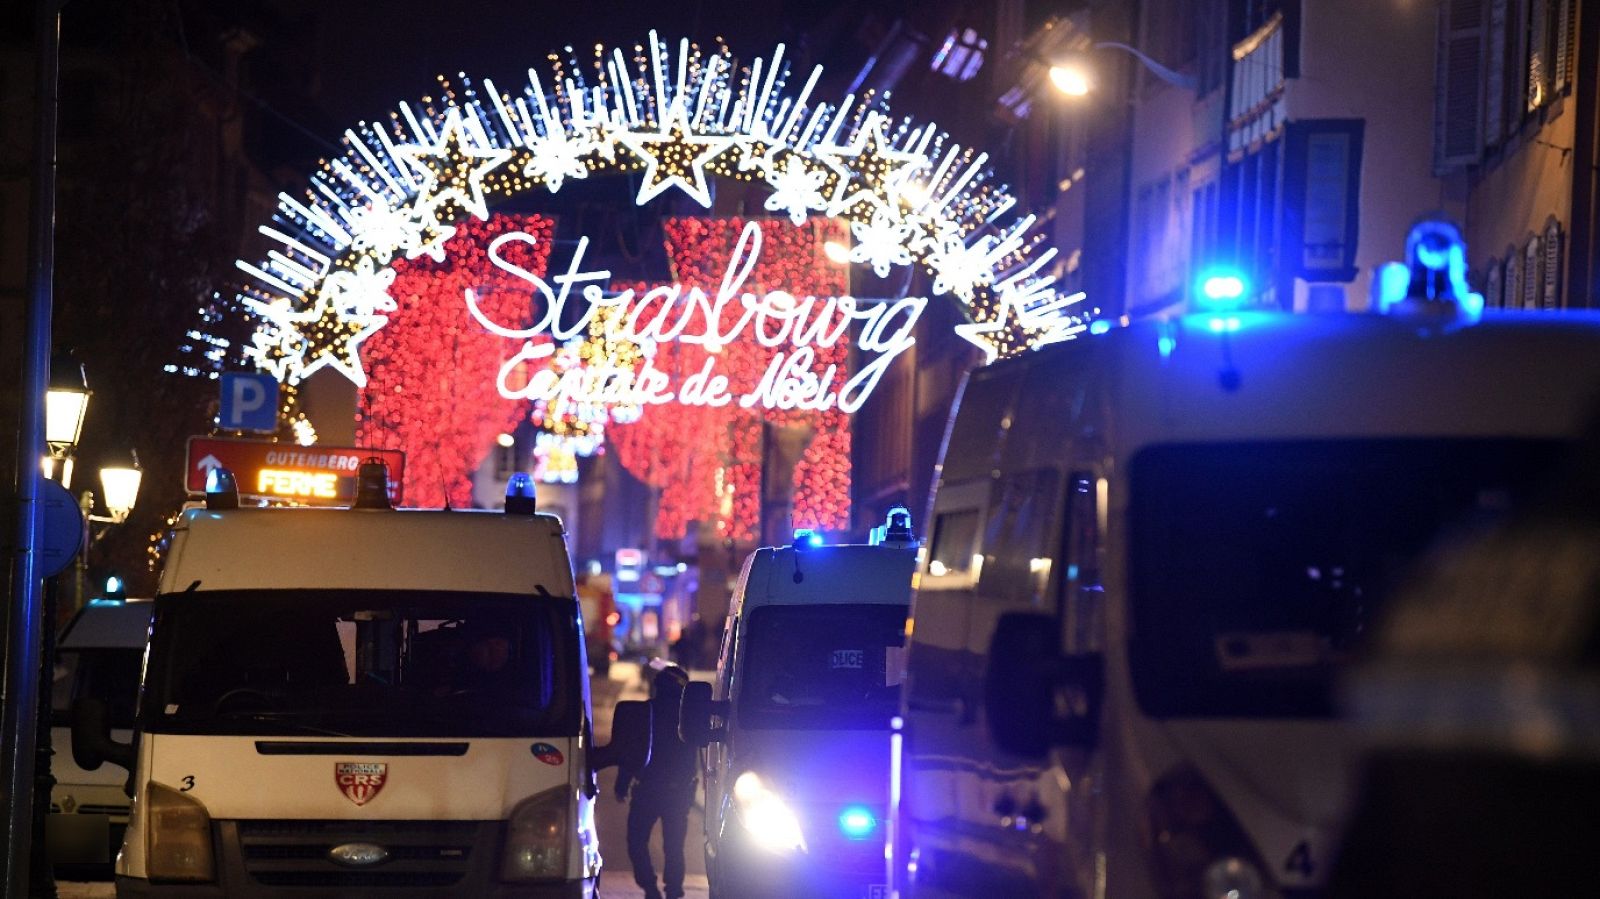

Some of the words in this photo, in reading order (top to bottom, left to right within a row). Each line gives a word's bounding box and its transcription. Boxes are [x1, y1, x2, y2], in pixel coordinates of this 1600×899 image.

[464, 220, 929, 414] Strasbourg
[496, 341, 674, 421] Capitale
[679, 356, 732, 407] de
[231, 376, 266, 424] P
[266, 451, 359, 470] GUTENBERG
[258, 469, 337, 497] FERME
[832, 651, 863, 667] OLICE
[179, 775, 196, 792] 3
[339, 774, 382, 786] CRS
[1284, 840, 1314, 879] 4
